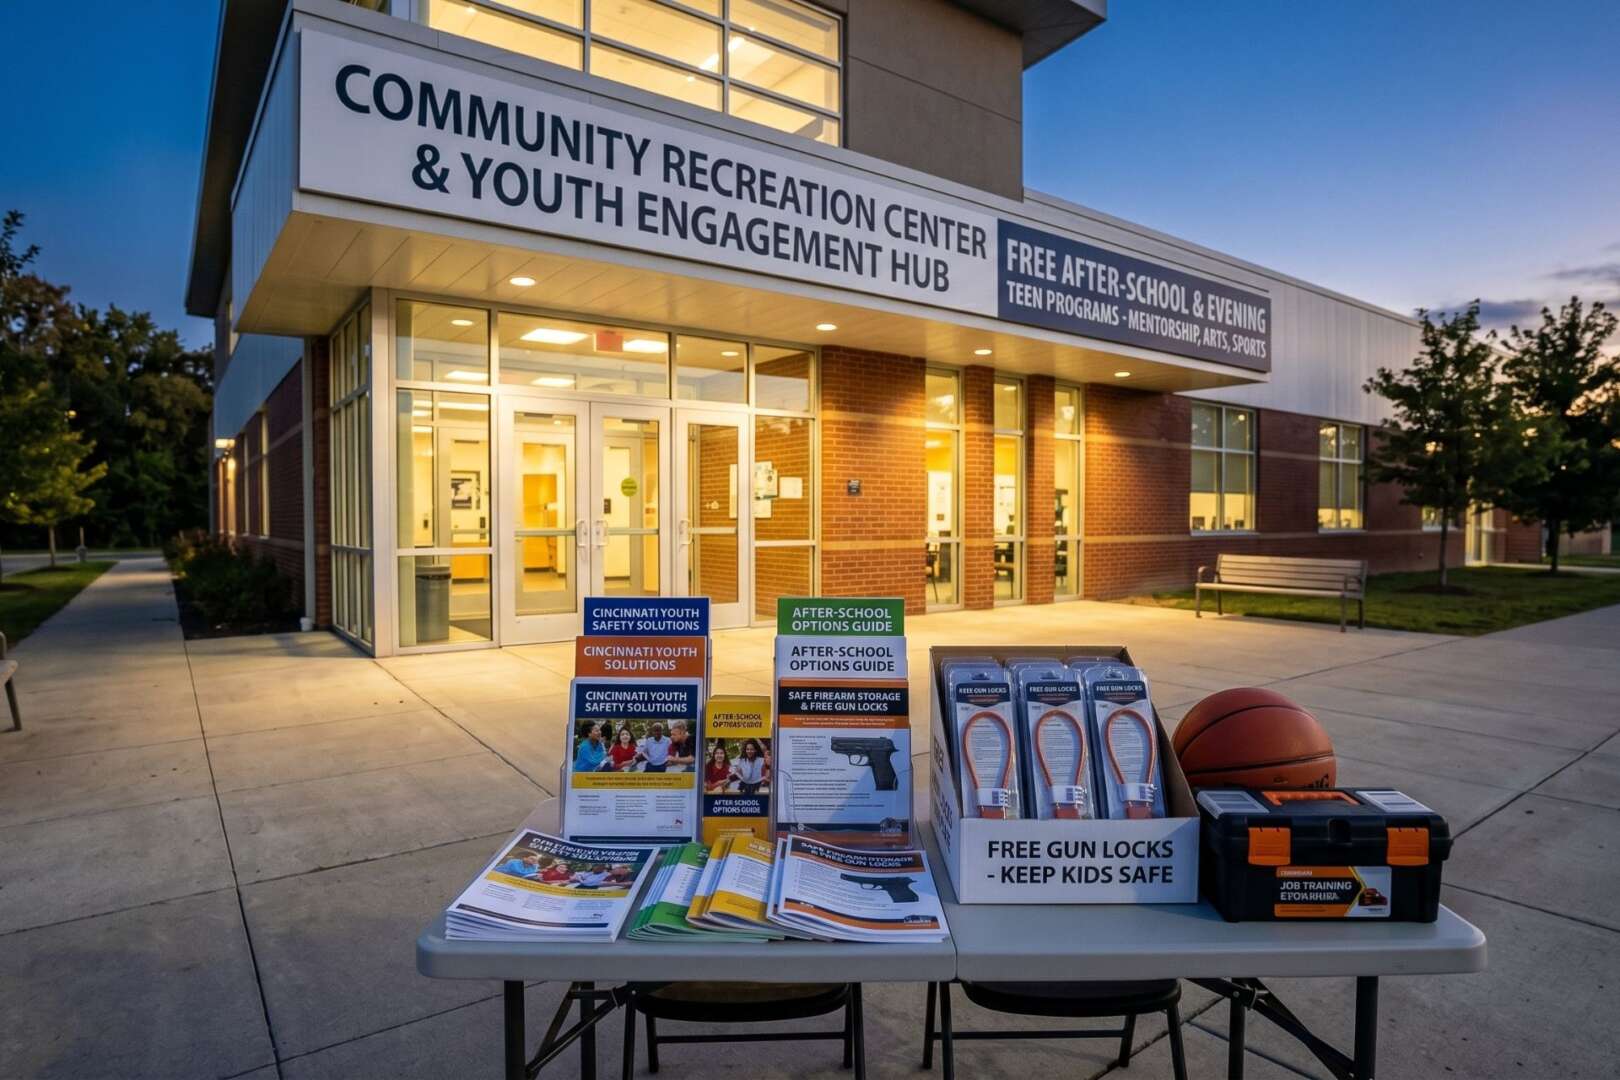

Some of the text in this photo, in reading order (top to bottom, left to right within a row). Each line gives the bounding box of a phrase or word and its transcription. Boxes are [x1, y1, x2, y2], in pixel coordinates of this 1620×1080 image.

[334, 63, 987, 260] COMMUNITY RECREATION CENTER
[411, 143, 950, 293] & YOUTH ENGAGEMENT HUB
[1006, 238, 1266, 334] FREE AFTER-SCHOOL & EVENING
[1006, 280, 1043, 309] TEEN
[1046, 289, 1120, 327] PROGRAMS
[1128, 310, 1202, 346] MENTORSHIP,
[1203, 327, 1231, 353] ARTS,
[1232, 333, 1267, 359] SPORTS
[592, 608, 700, 618] CINCINNATI YOUTH
[792, 607, 892, 619] AFTER-SCHOOL
[592, 620, 700, 631] SAFETY SOLUTIONS
[791, 620, 893, 632] OPTIONS GUIDE
[583, 646, 698, 657] CINCINNATI YOUTH
[791, 646, 893, 658] AFTER-SCHOOL
[604, 659, 677, 671] SOLUTIONS
[789, 660, 895, 672] OPTIONS GUIDE
[585, 691, 687, 701] CINCINNATI YOUTH
[788, 691, 901, 701] SAFE FIREARM STORAGE
[585, 702, 688, 713] SAFETY SOLUTIONS
[800, 702, 888, 712] & FREE GUN LOCKS
[987, 840, 1174, 859] FREE GUN LOCKS
[1001, 865, 1056, 884] KEEP
[1062, 865, 1113, 884] KIDS
[1118, 865, 1174, 884] SAFE
[1280, 881, 1353, 890] JOB TRAINING
